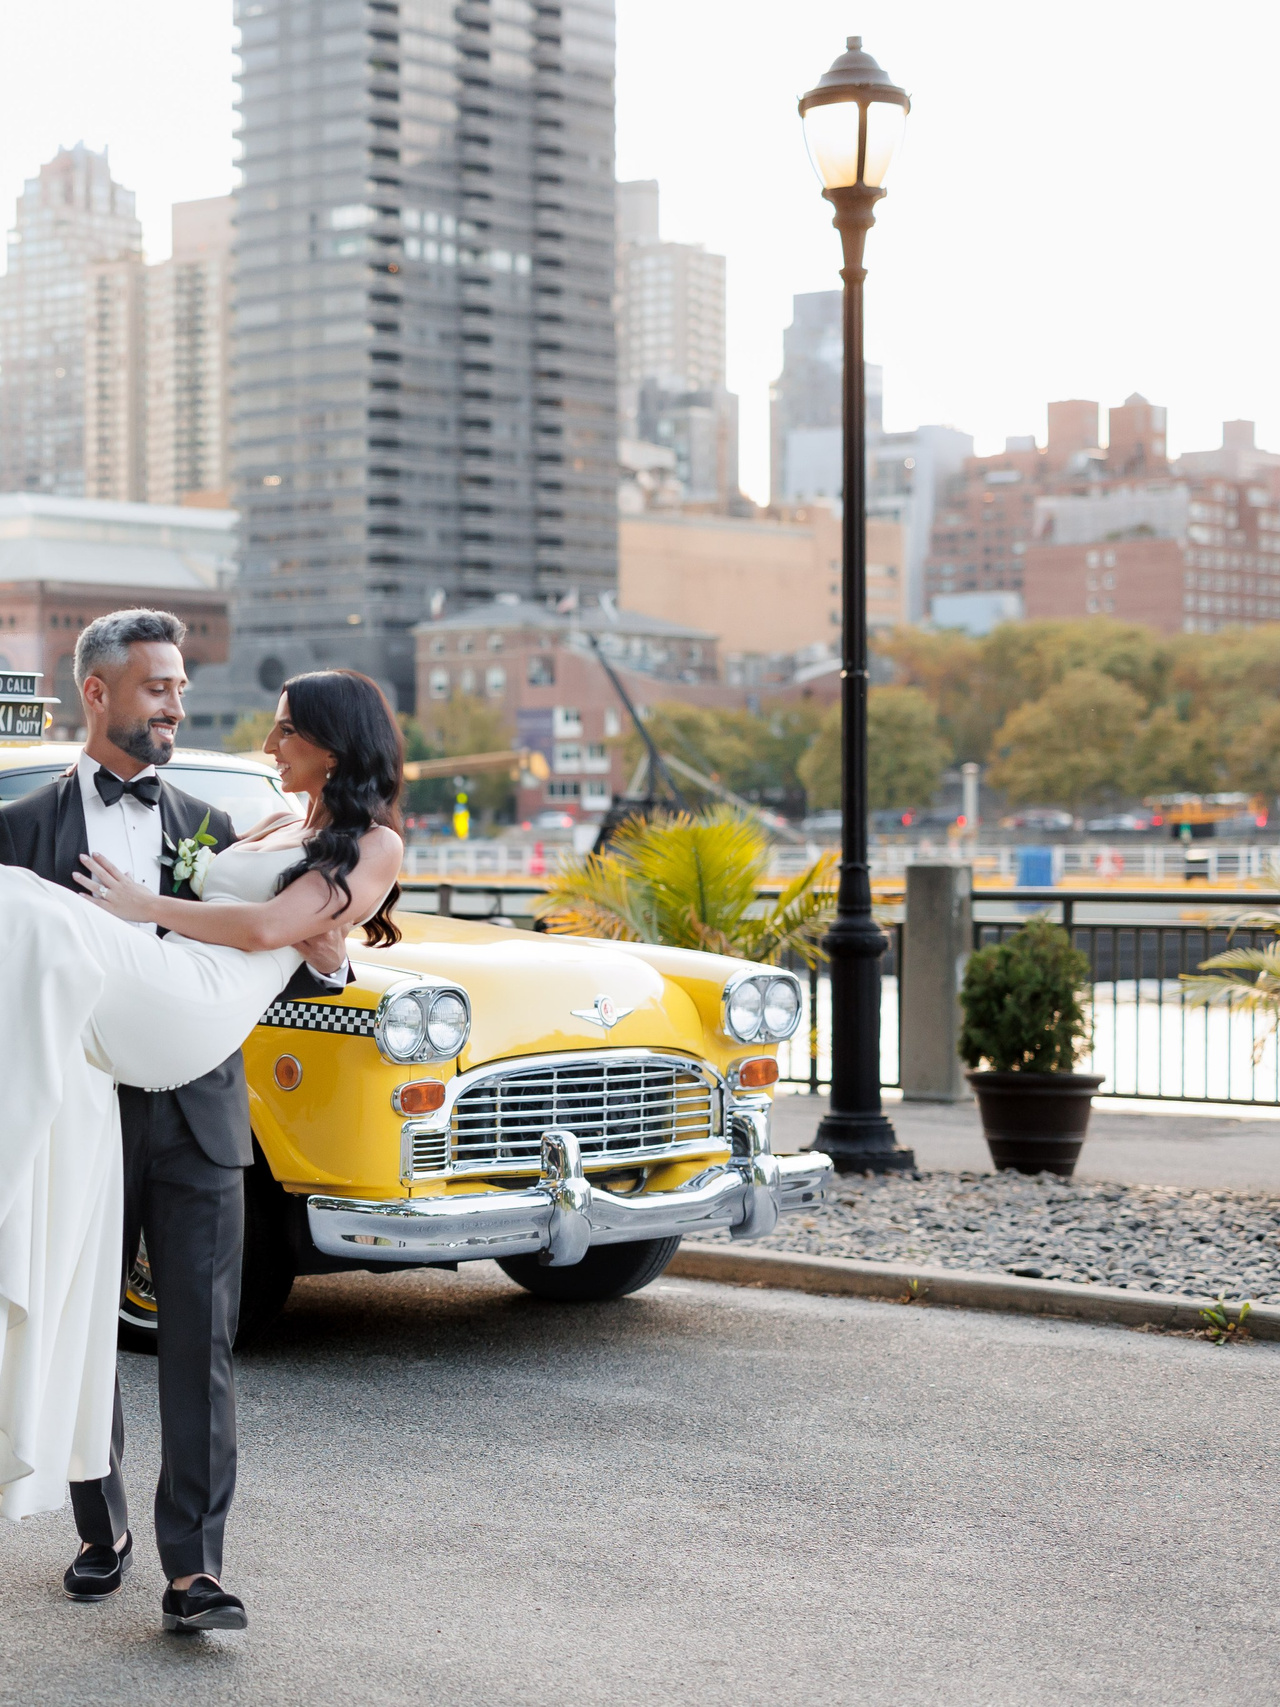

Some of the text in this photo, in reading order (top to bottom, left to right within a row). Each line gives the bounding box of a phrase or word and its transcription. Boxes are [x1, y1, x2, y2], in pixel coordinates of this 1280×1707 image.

[6, 677, 34, 693] CALL
[19, 705, 39, 718] OFF
[16, 720, 40, 734] DUTY
